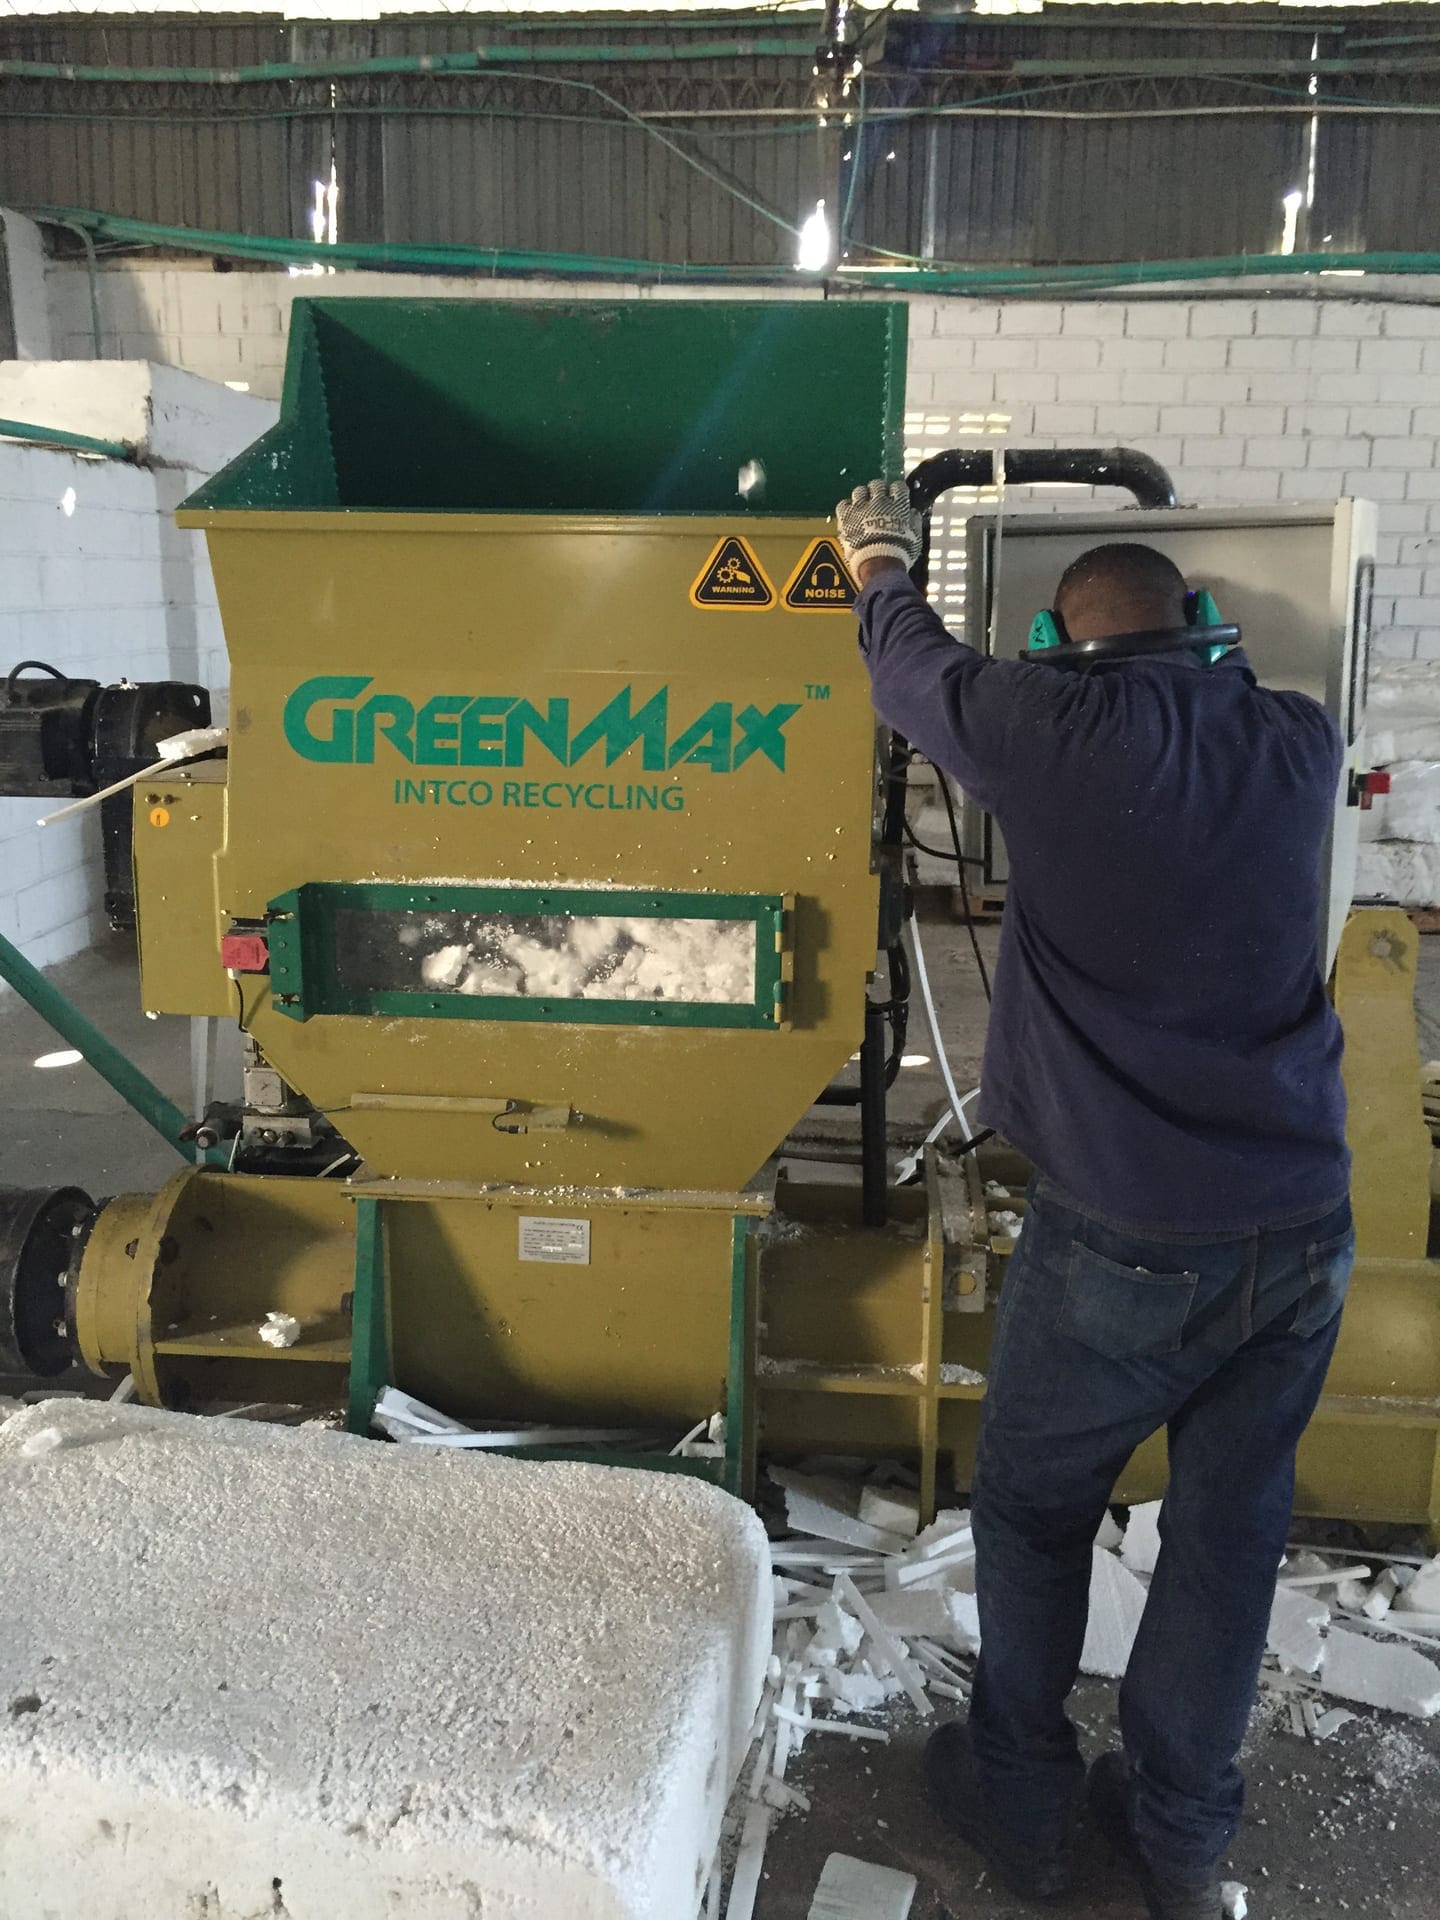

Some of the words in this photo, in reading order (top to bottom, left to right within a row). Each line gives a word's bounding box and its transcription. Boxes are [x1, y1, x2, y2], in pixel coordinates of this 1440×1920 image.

[712, 586, 755, 594] WARNING
[805, 588, 846, 599] NOISE
[394, 779, 493, 806] INTCO
[503, 782, 684, 811] RECYCLING
